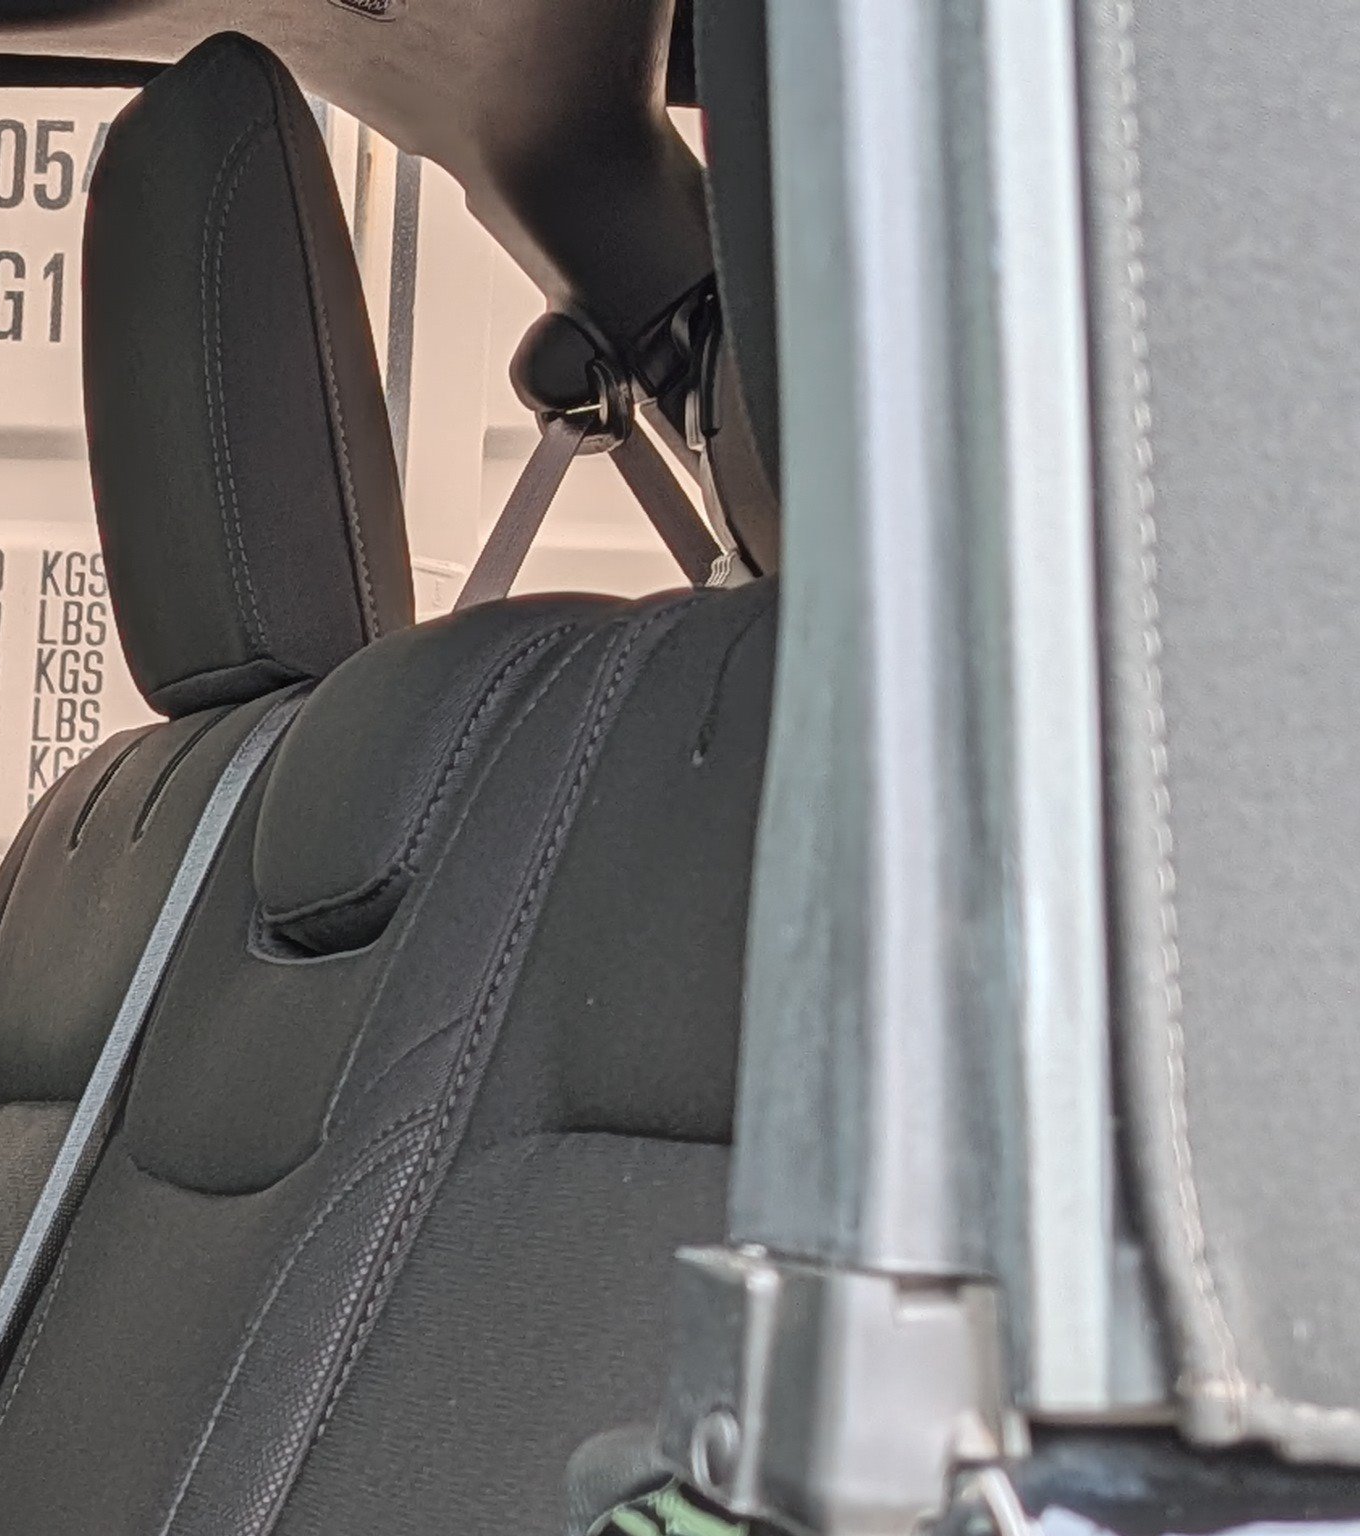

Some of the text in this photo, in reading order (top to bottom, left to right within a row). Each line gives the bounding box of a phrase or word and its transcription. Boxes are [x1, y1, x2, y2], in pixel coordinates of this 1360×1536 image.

[40, 550, 108, 596] KGS
[37, 600, 107, 646] LBS
[34, 648, 103, 695] KGS
[31, 697, 101, 743] LBS
[28, 746, 96, 790] KG
